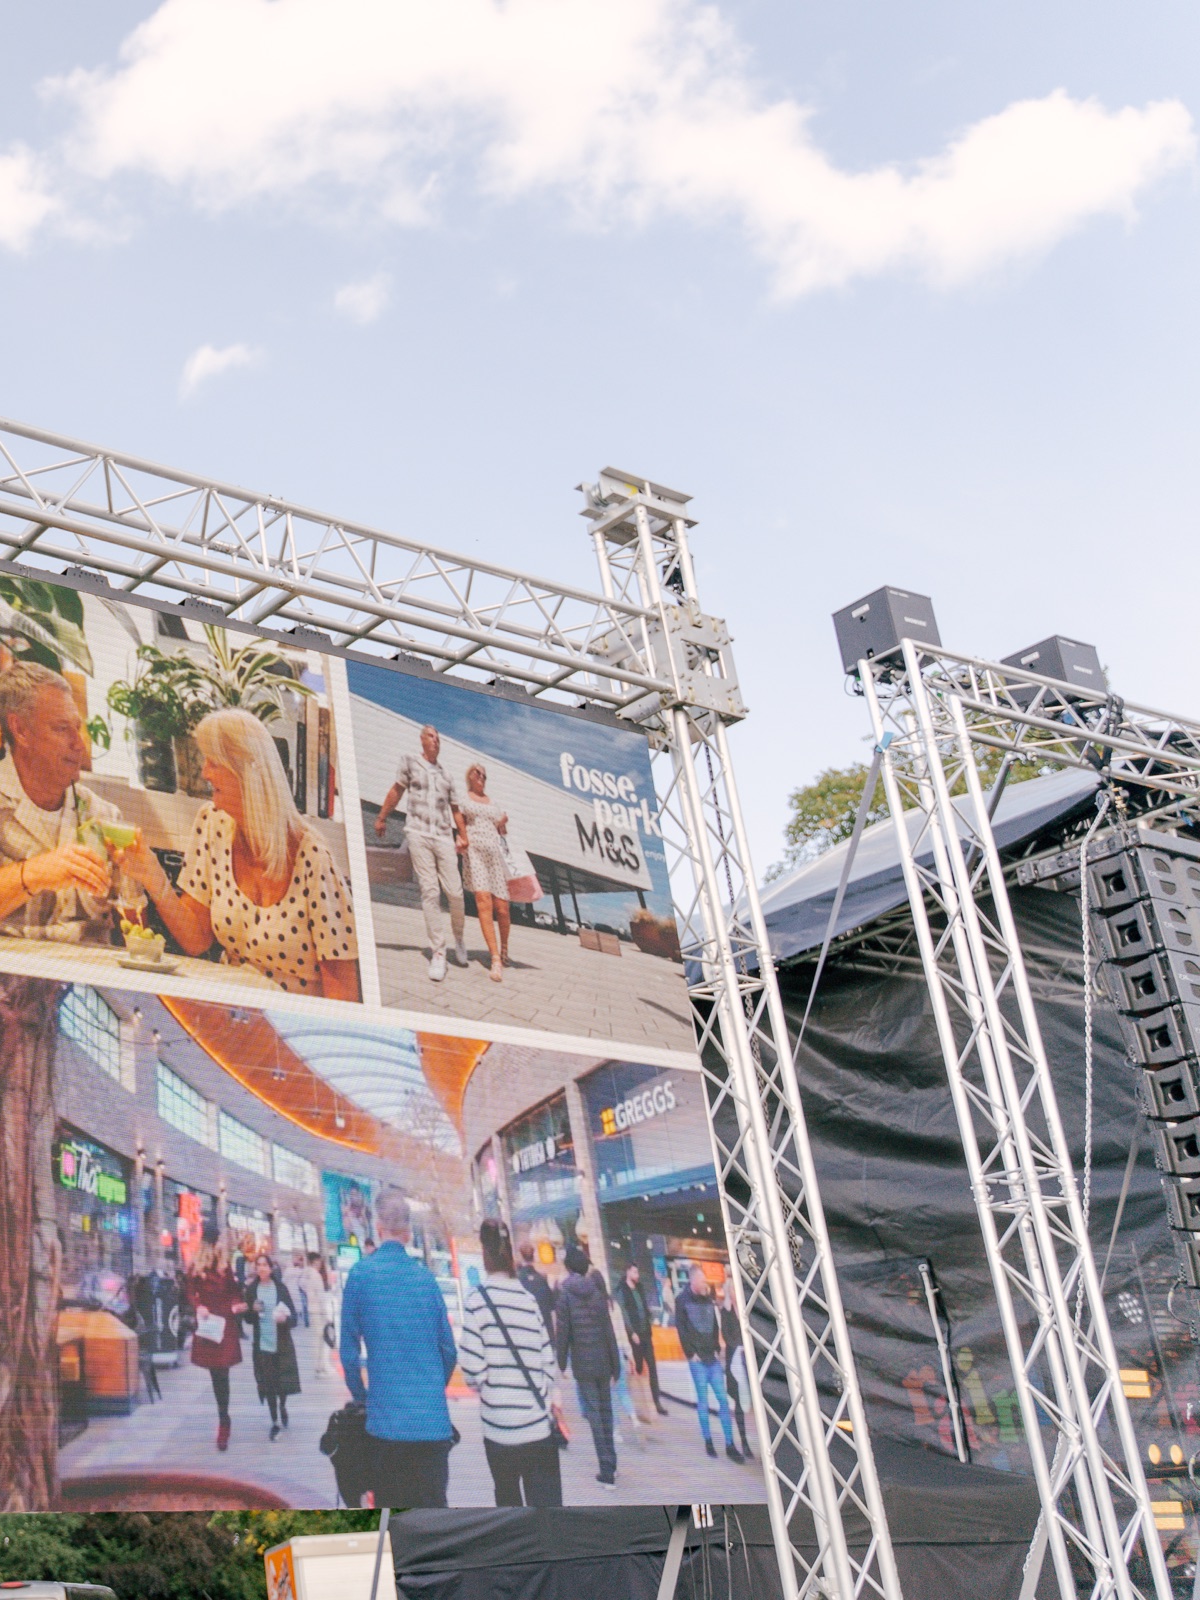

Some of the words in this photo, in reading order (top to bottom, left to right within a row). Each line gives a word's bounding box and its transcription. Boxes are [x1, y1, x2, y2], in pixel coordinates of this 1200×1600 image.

[560, 752, 638, 803] fosse.
[574, 813, 640, 870] M&S
[593, 798, 662, 838] park
[615, 1081, 676, 1131] GREGGS
